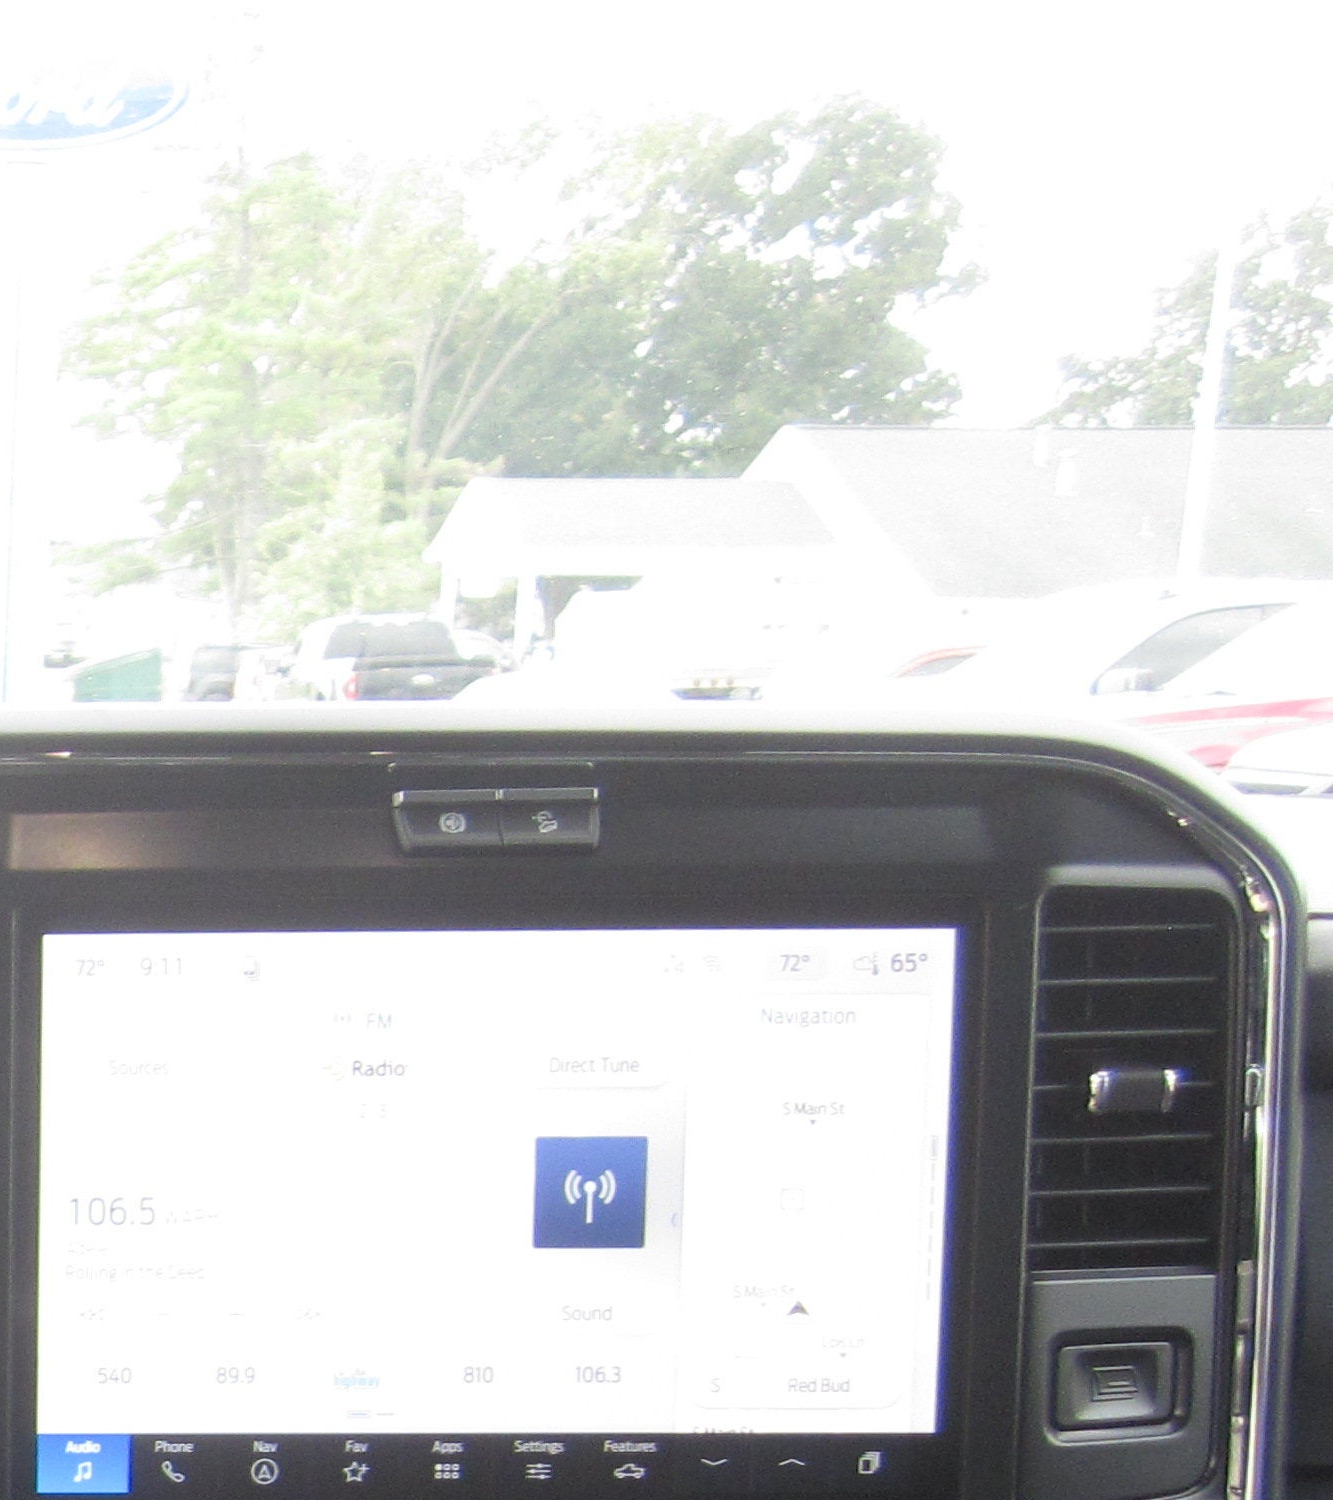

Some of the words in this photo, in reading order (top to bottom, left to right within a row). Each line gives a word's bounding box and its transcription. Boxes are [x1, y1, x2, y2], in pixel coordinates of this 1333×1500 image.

[889, 951, 929, 973] 65°
[760, 1007, 857, 1028] Navigation
[351, 1059, 406, 1078] Radio
[549, 1056, 596, 1074] Direct
[601, 1056, 640, 1074] Tune
[69, 1196, 157, 1227] 106.5
[561, 1304, 614, 1322] Sound
[96, 1366, 134, 1384] 540
[215, 1366, 257, 1385] 89.9
[462, 1366, 494, 1384] 810
[574, 1366, 622, 1384] 106.3
[787, 1378, 818, 1393] Red
[820, 1378, 851, 1393] Bud
[64, 1440, 102, 1454] Audio
[154, 1440, 195, 1455] Phone
[252, 1440, 278, 1454] Nav
[344, 1440, 369, 1454] Fav
[431, 1440, 464, 1457] Apps
[513, 1439, 565, 1457] Settings
[603, 1439, 657, 1455] Features
